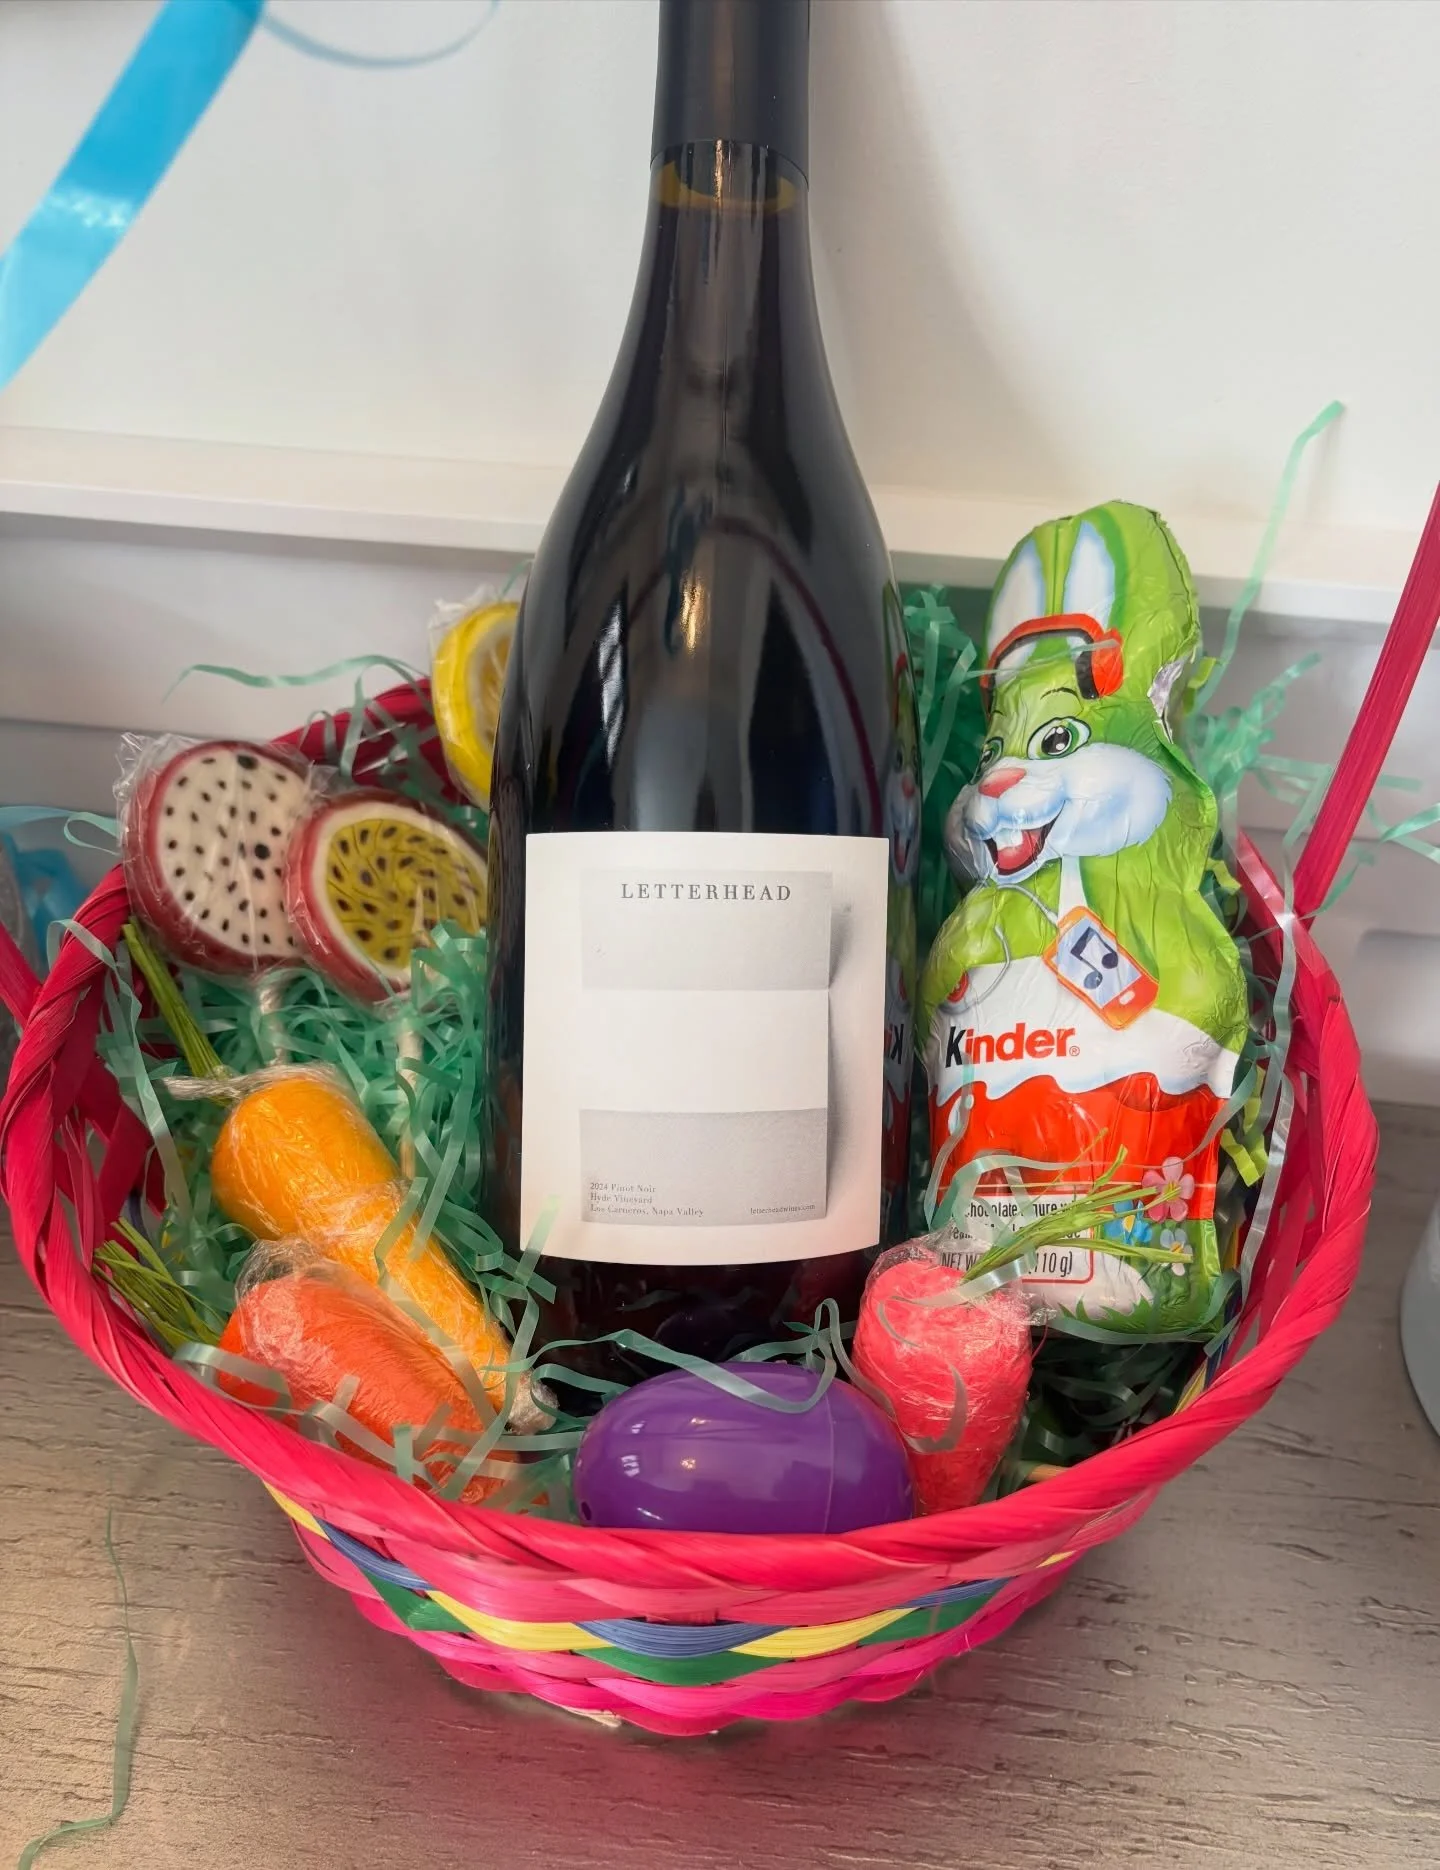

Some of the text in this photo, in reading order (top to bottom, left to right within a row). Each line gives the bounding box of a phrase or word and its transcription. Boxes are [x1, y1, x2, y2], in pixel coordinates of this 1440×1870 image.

[621, 883, 791, 901] LETTERHEAD
[590, 1182, 656, 1193] 2024 Pinot Noir
[590, 1192, 653, 1205] Hyde Vineyard
[590, 1203, 704, 1218] Los Carneros, Napa Valley
[750, 1203, 816, 1215] letterheadwines.com
[965, 1202, 1018, 1217] hocolate
